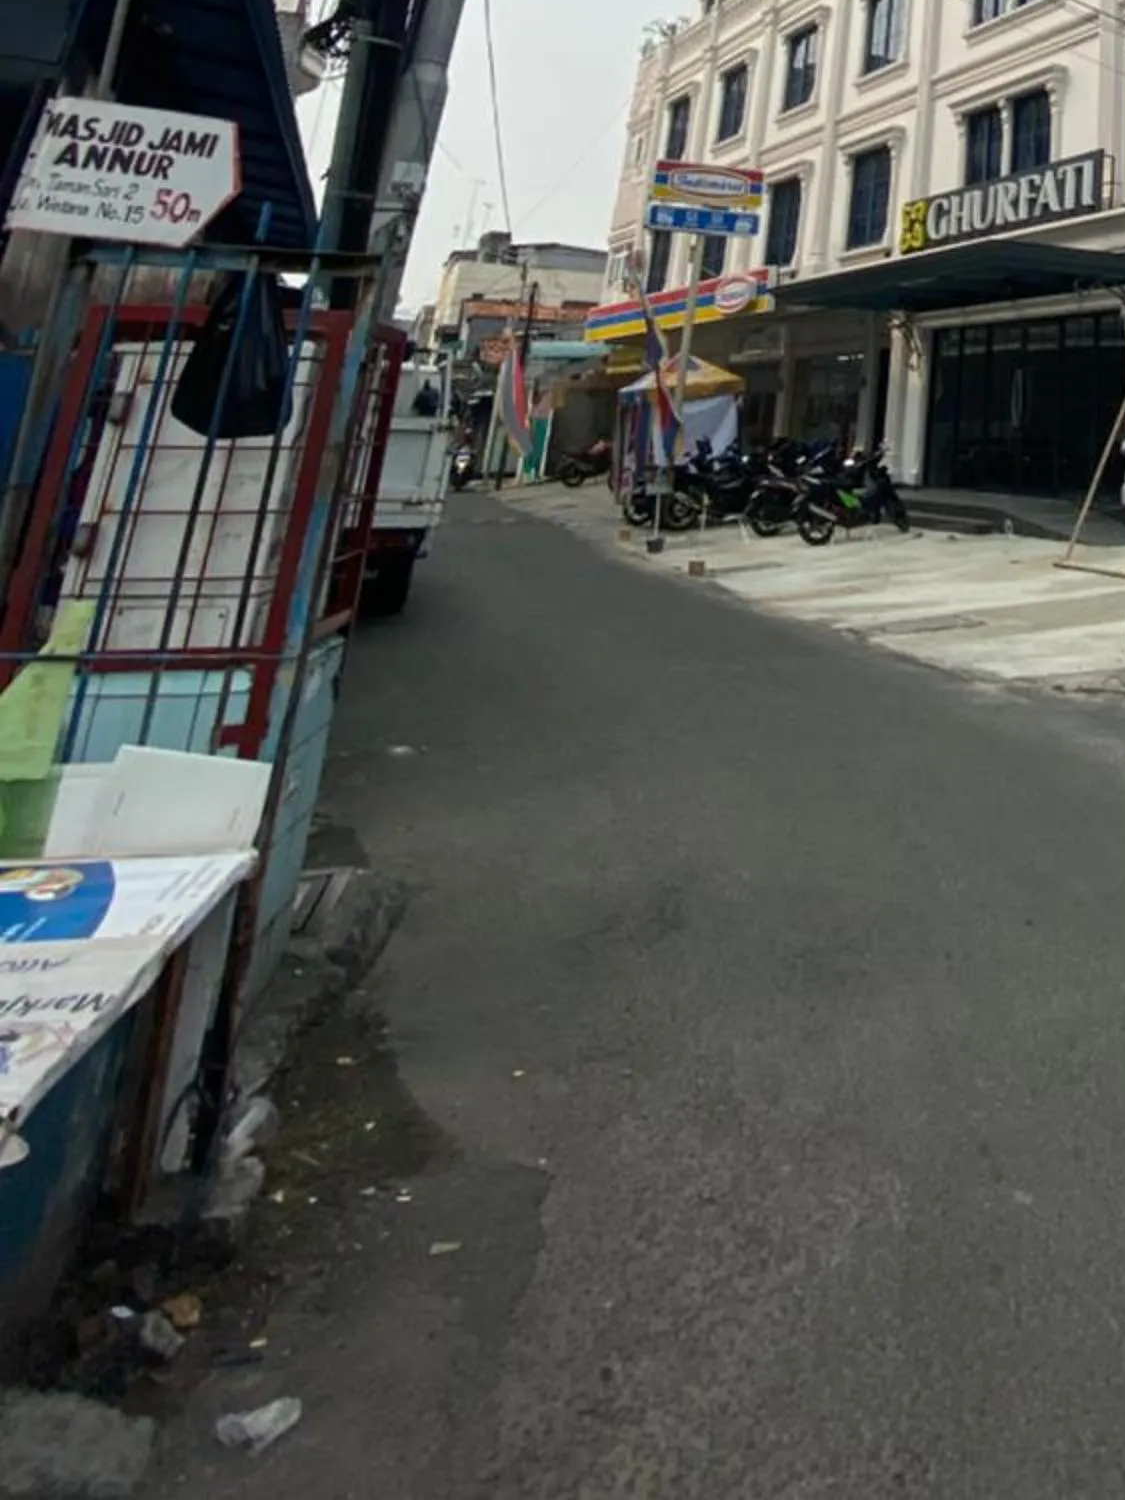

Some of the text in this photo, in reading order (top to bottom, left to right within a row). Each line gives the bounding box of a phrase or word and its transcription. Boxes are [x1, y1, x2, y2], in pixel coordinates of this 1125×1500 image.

[44, 109, 220, 159] MASJID JAMI
[53, 141, 175, 181] ANNUR
[926, 159, 1096, 240] GHURFATI
